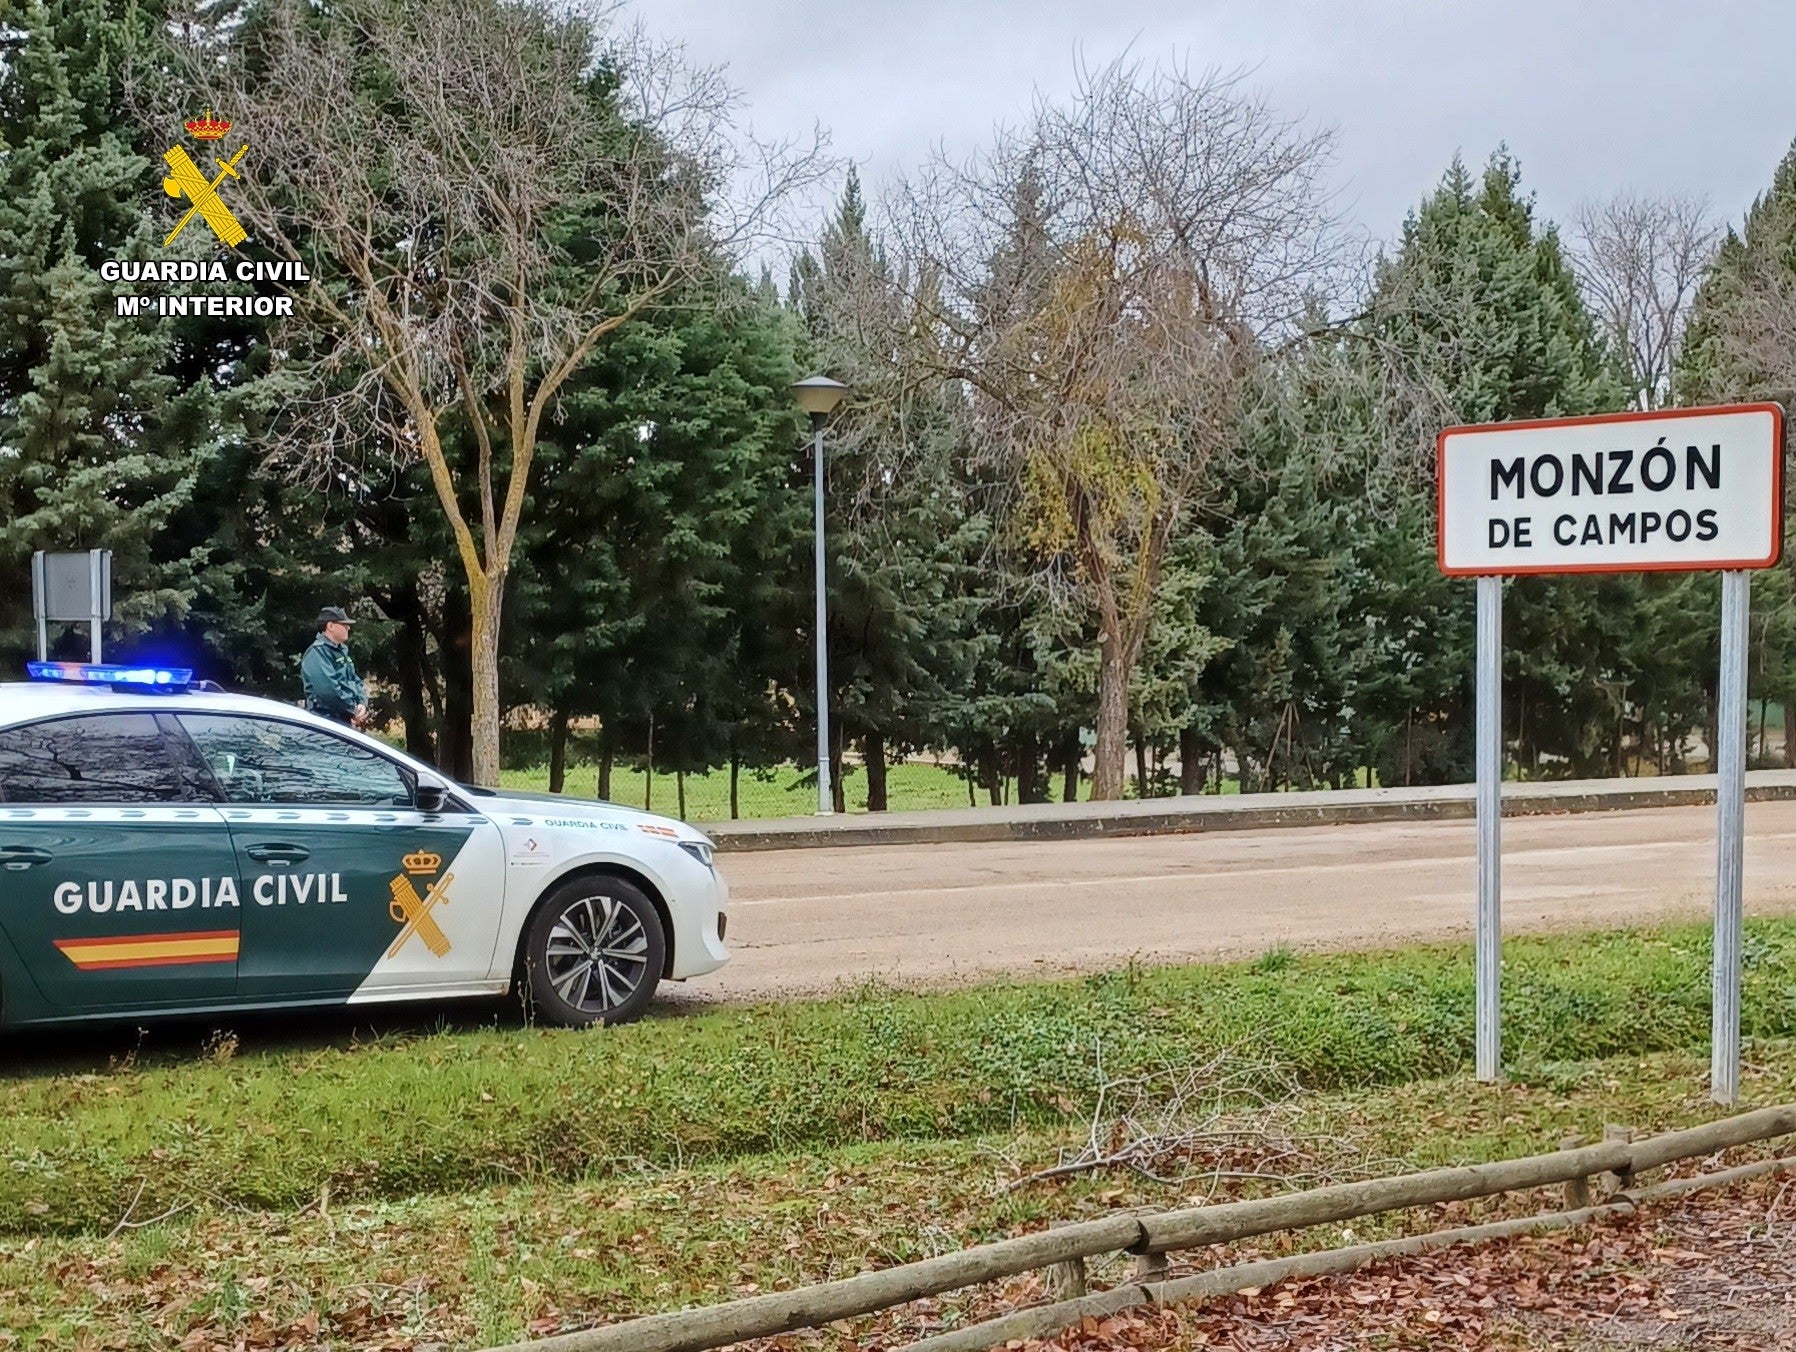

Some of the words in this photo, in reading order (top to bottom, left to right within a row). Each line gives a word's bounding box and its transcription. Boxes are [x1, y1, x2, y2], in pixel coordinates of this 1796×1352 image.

[1490, 436, 1721, 500] MONZÓN
[1488, 517, 1532, 548] DE
[1553, 508, 1719, 546] CAMPOS
[544, 819, 598, 830] GUARDIA
[599, 822, 628, 831] CIVIL
[53, 875, 240, 914] GUARDIA
[252, 872, 348, 906] CIVIL
